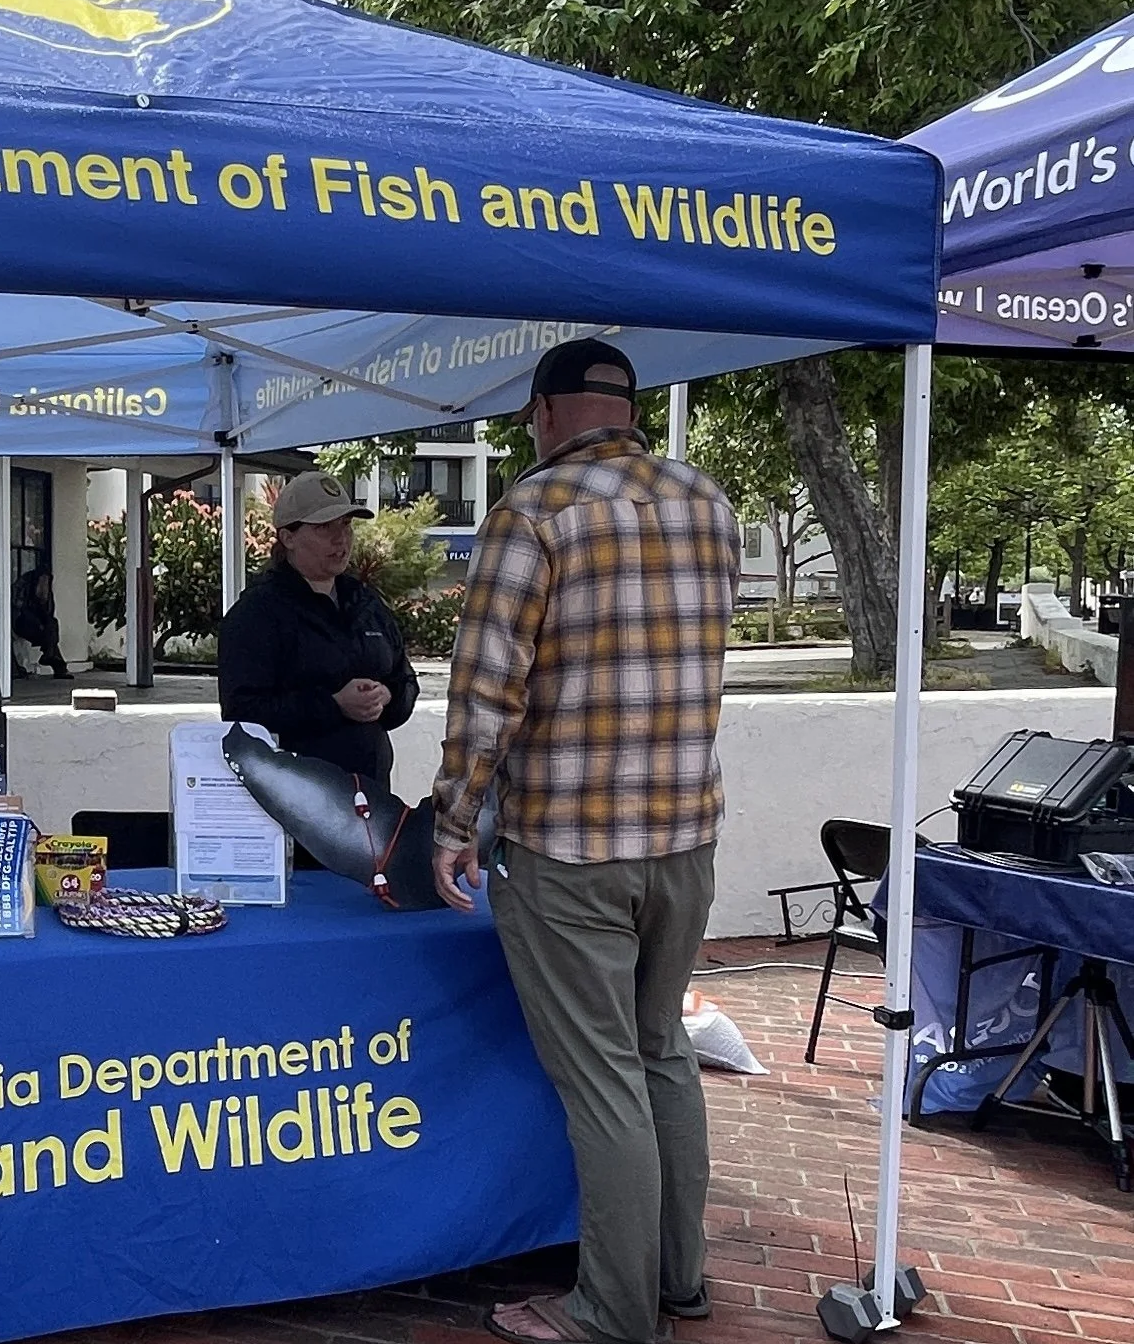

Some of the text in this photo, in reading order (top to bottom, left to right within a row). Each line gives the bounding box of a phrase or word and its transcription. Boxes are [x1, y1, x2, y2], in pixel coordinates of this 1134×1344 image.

[218, 153, 287, 210] of
[310, 157, 460, 223] Fish
[481, 180, 600, 236] and
[614, 184, 837, 255] Wildlife
[943, 137, 1117, 225] World's
[449, 551, 470, 561] PLAZ
[51, 840, 92, 848] Crayola
[62, 877, 79, 889] 64
[59, 1025, 355, 1100] Department
[368, 1019, 412, 1065] of
[151, 1082, 422, 1174] Wildlife
